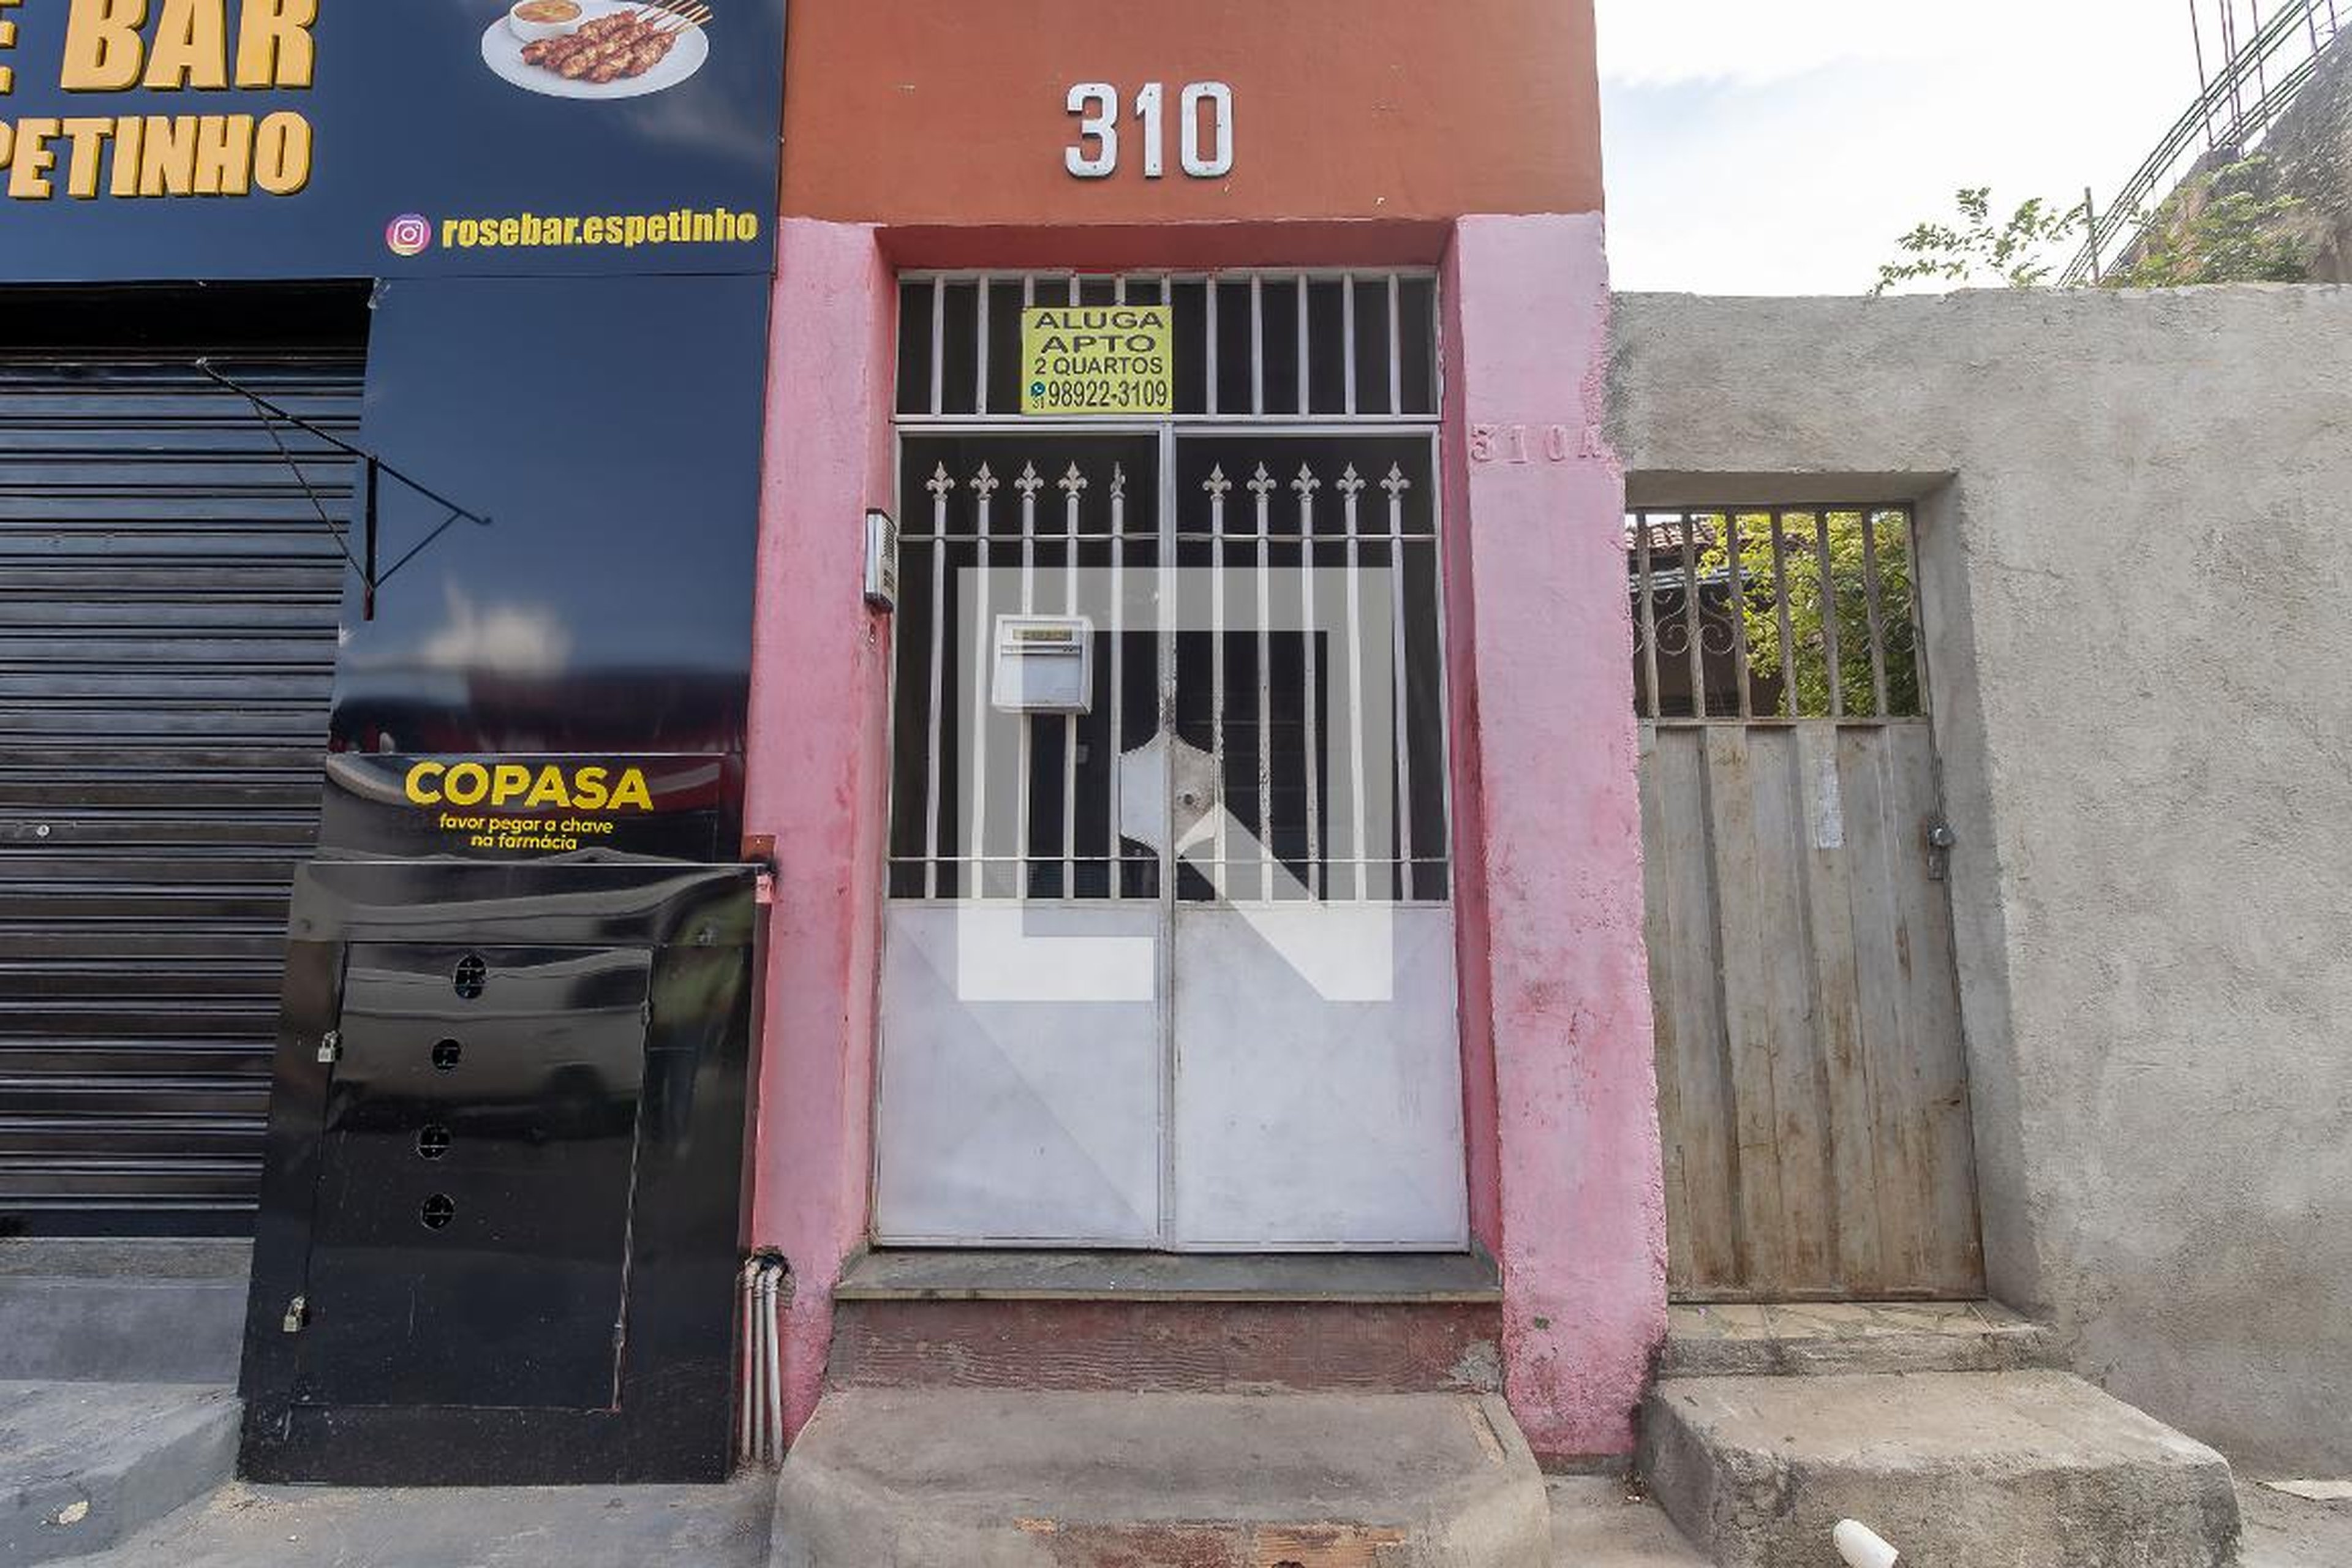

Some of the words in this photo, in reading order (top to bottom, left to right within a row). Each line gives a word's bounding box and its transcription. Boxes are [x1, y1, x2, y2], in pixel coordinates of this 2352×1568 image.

[61, 0, 317, 91] BAR
[1065, 81, 1233, 179] 310
[442, 208, 758, 248] rosebar.espetinho
[1035, 311, 1164, 330] ALUGA
[1041, 334, 1156, 354] APTO
[1034, 357, 1047, 375] 2
[1053, 356, 1163, 376] QUARTOS
[1048, 380, 1167, 407] 98922-3109
[405, 761, 654, 812] COPASA
[440, 812, 484, 828] favor
[488, 817, 542, 835] pegar
[545, 820, 556, 832] a
[560, 816, 613, 834] chave
[470, 834, 493, 848] na
[498, 832, 578, 851] farmácia
